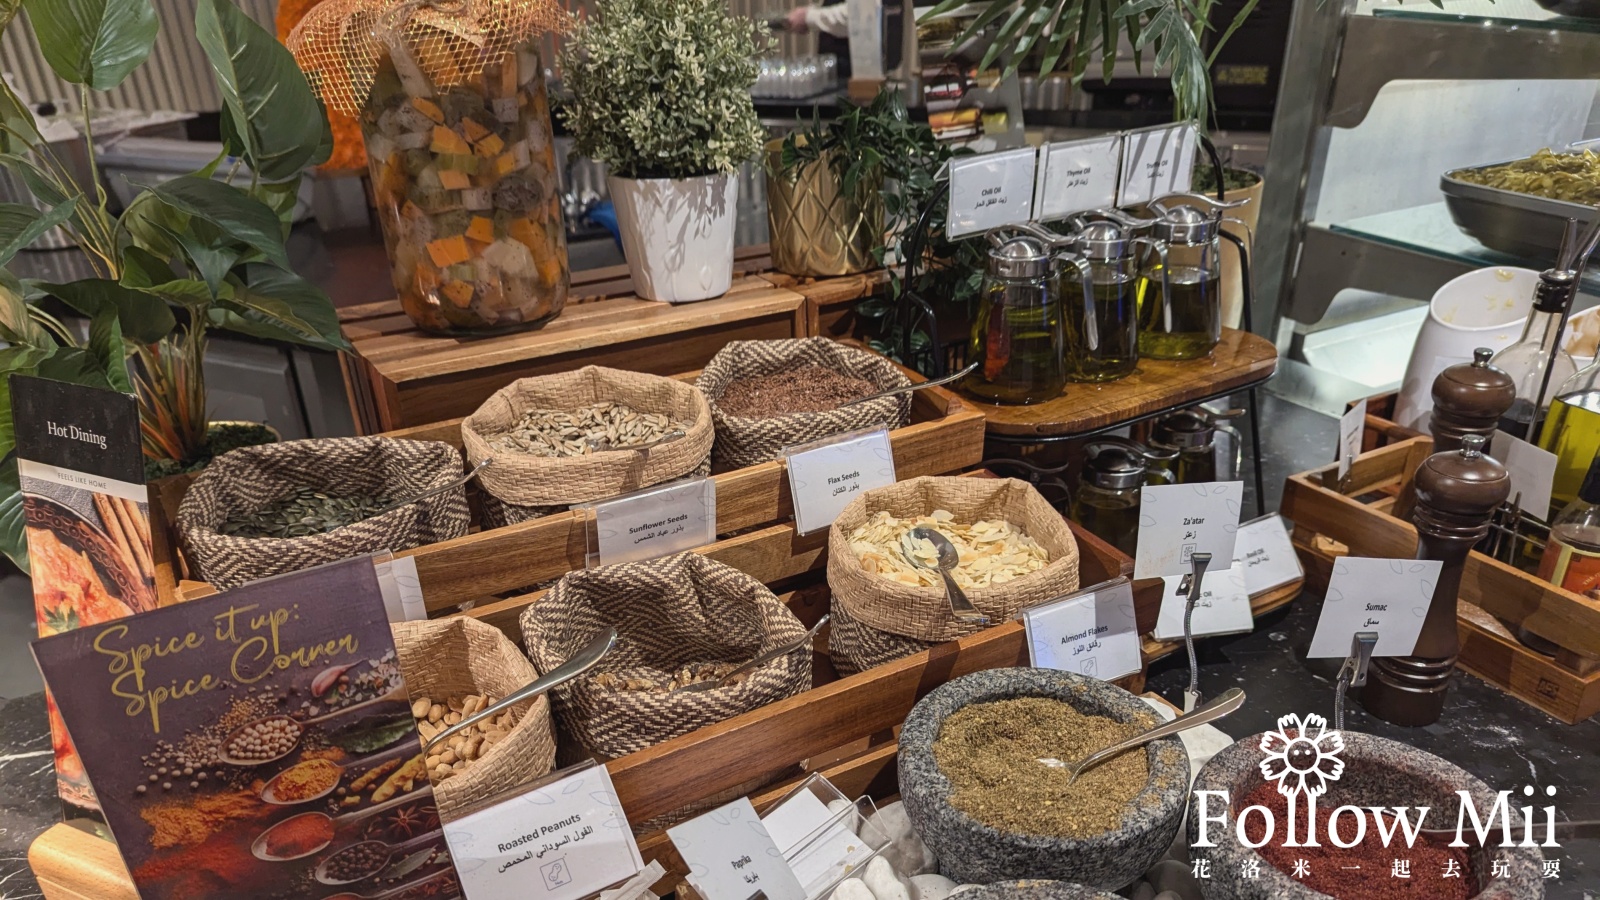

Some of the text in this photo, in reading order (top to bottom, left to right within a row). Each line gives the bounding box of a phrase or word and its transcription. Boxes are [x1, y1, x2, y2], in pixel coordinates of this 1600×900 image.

[981, 186, 1001, 196] Chili Oil
[47, 421, 107, 449] Hot Dining
[57, 472, 107, 489] FEELS LIKE HOME
[841, 471, 860, 481] Seeds
[629, 514, 688, 534] Sunflower Seeds
[1183, 517, 1205, 525] Za'atar
[1183, 531, 1197, 540] زعتر
[1365, 602, 1388, 611] Sumac
[1363, 617, 1379, 627] سماق
[1061, 625, 1108, 644] Almond Flakes
[93, 603, 299, 692] Spice it up:
[111, 634, 359, 733] Spice Corner
[498, 814, 582, 853] Roasted Peanuts
[536, 834, 571, 858] السوداني
[498, 850, 534, 873] المحمص
[731, 855, 752, 870] Paprika
